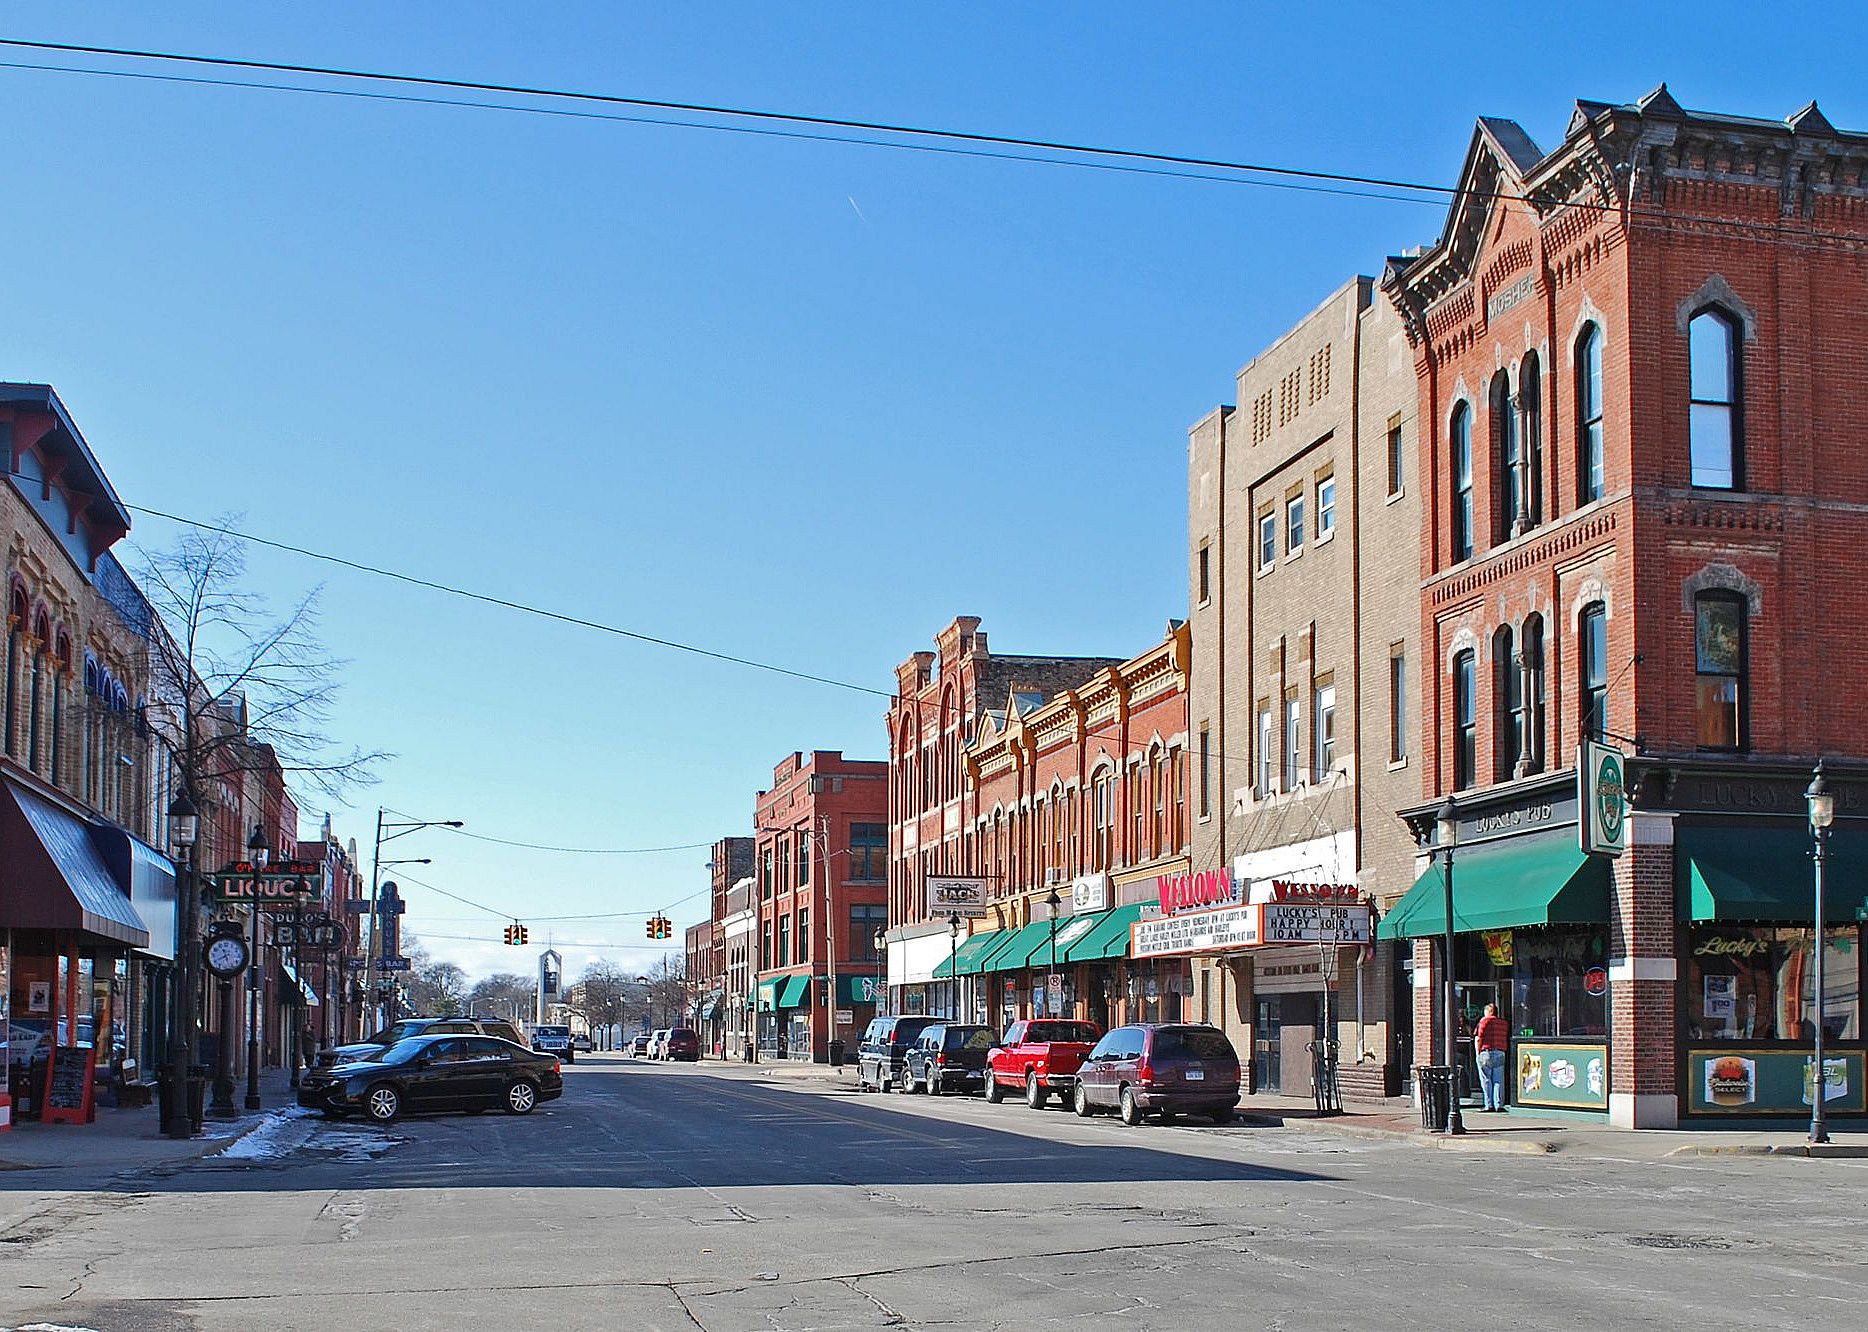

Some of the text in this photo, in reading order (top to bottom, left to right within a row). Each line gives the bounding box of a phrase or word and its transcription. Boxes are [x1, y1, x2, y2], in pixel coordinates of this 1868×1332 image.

[1526, 801, 1552, 823] PUB
[1157, 866, 1232, 914] WESTOWN
[1277, 907, 1349, 918] LUCKY'S PUB
[1270, 918, 1310, 929] HAPPY
[1694, 936, 1769, 957] Lucky's
